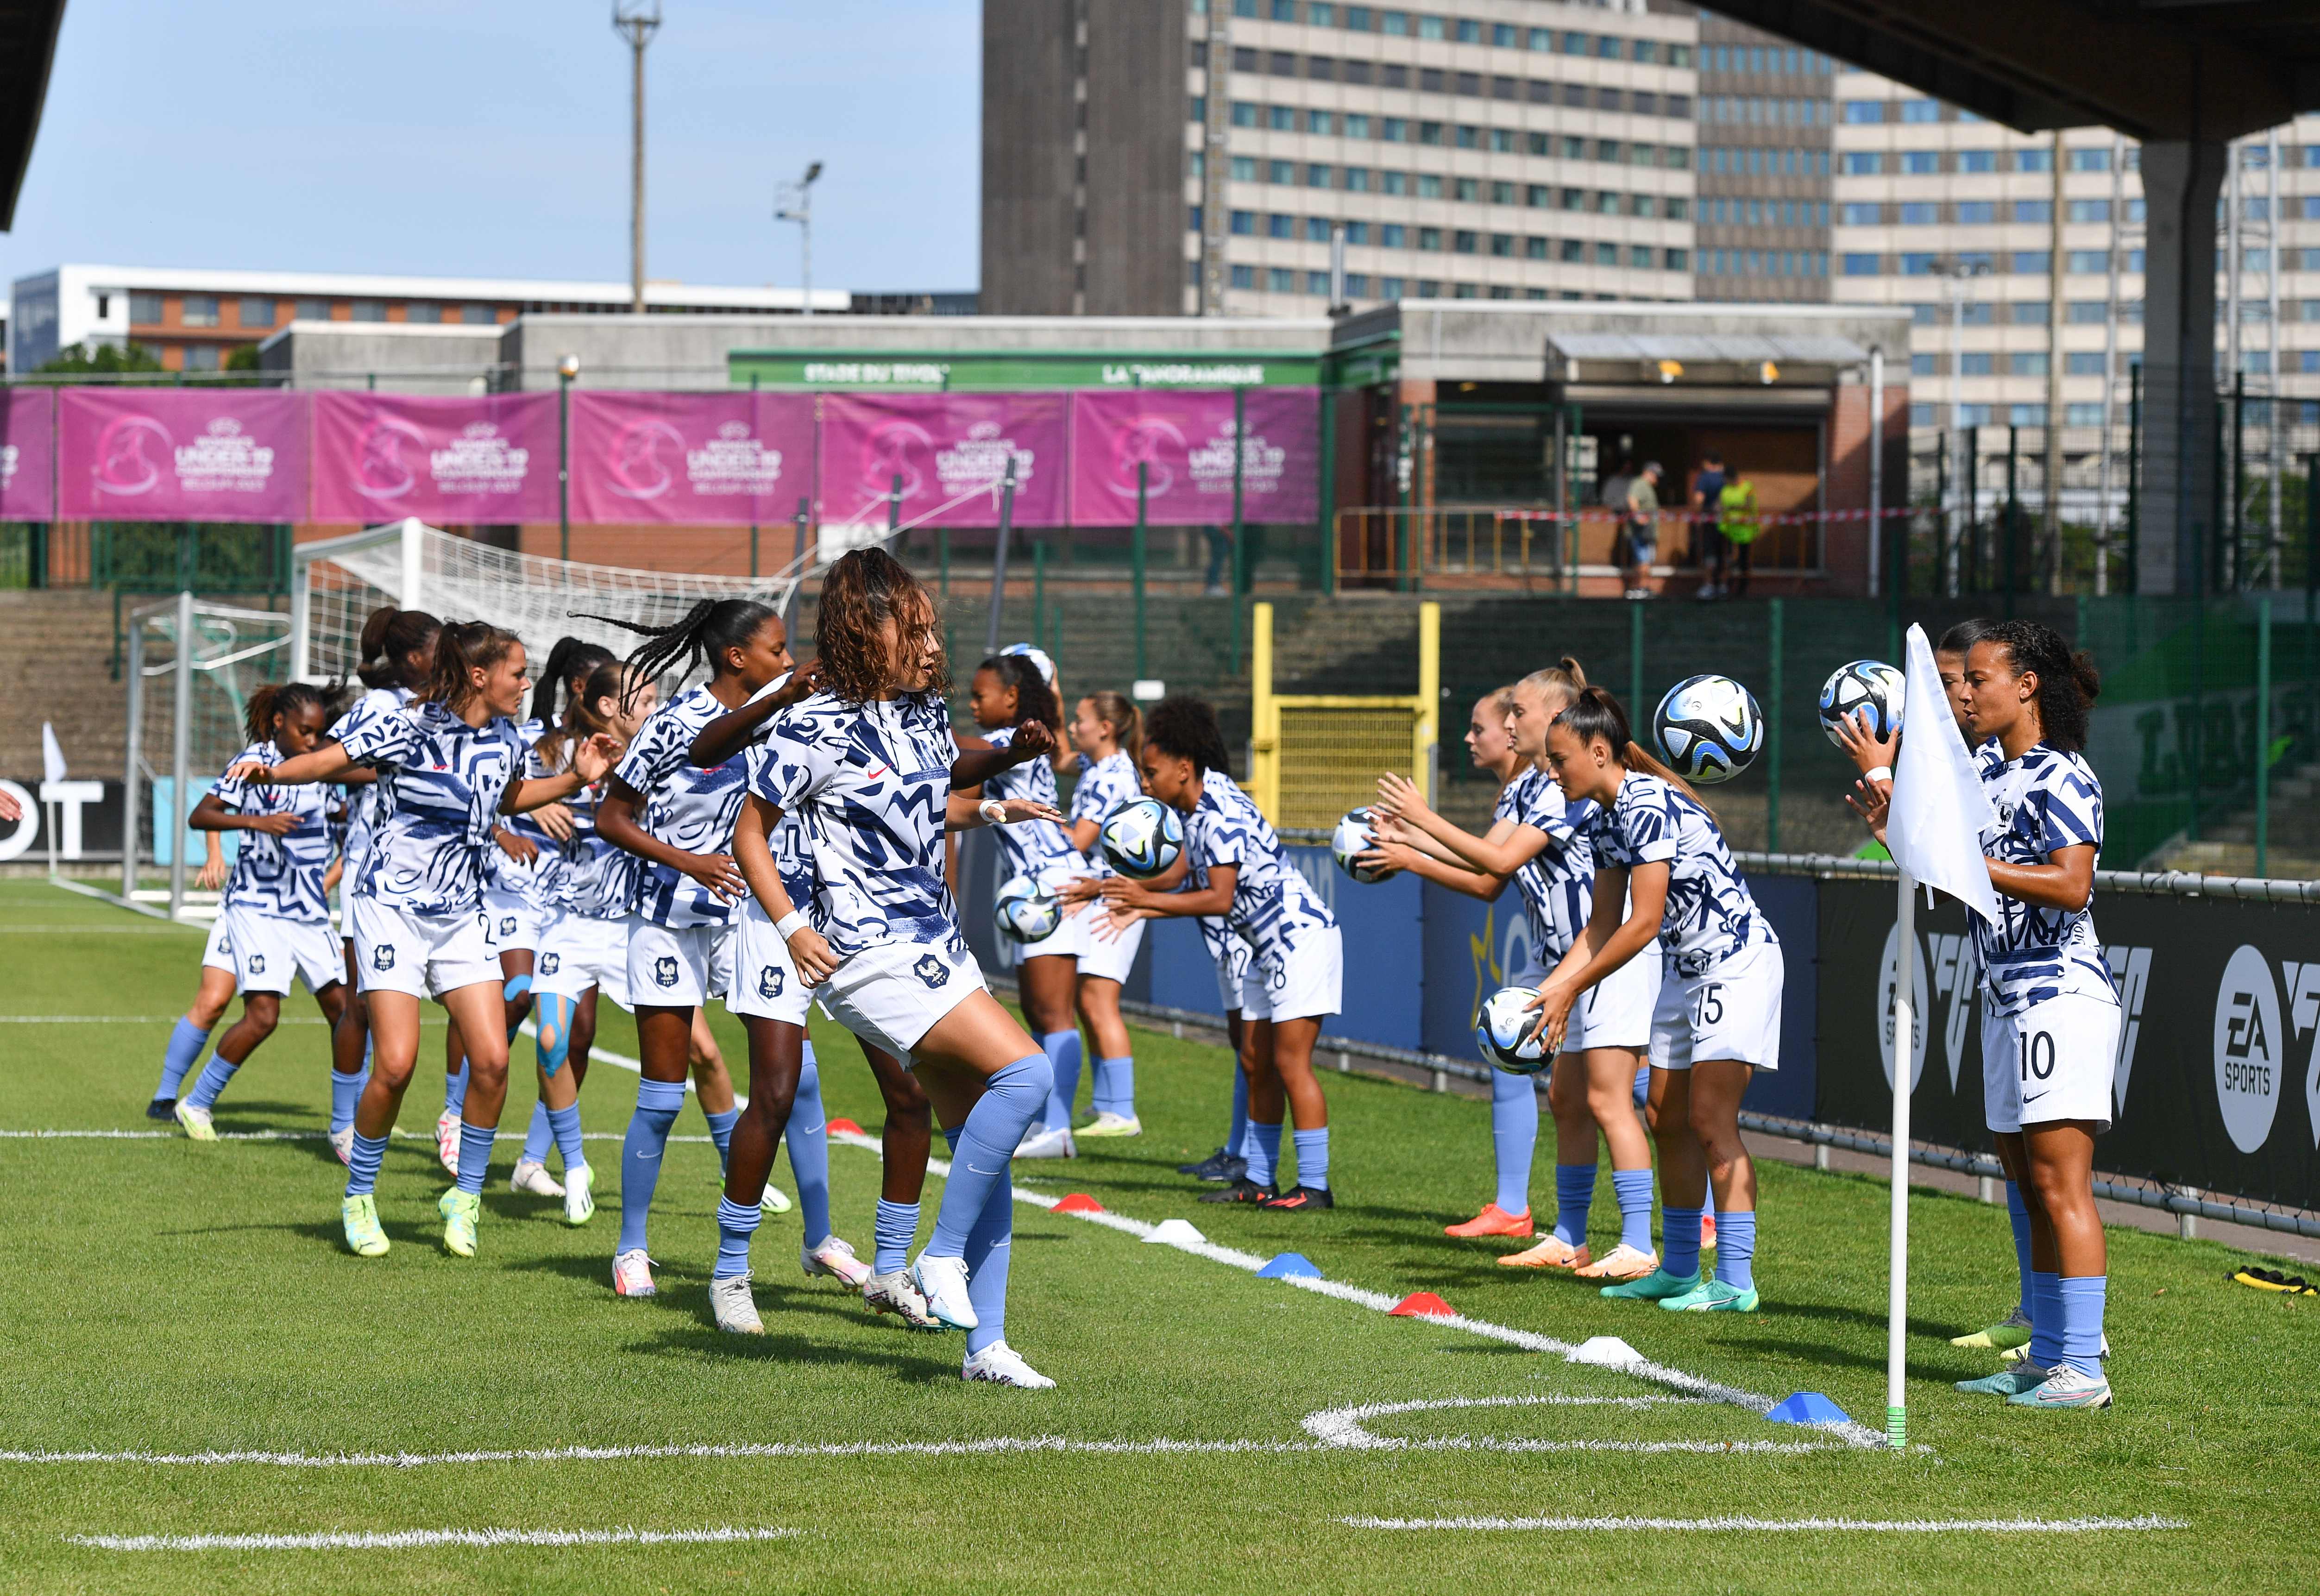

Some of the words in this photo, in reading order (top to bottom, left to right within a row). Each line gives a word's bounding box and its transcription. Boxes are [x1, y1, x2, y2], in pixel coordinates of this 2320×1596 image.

[893, 364, 949, 383] TIVOL
[1697, 985, 1723, 1027] 15
[2226, 991, 2270, 1061] EA
[2020, 1030, 2055, 1081] 10
[2225, 1062, 2270, 1096] SPORTS
